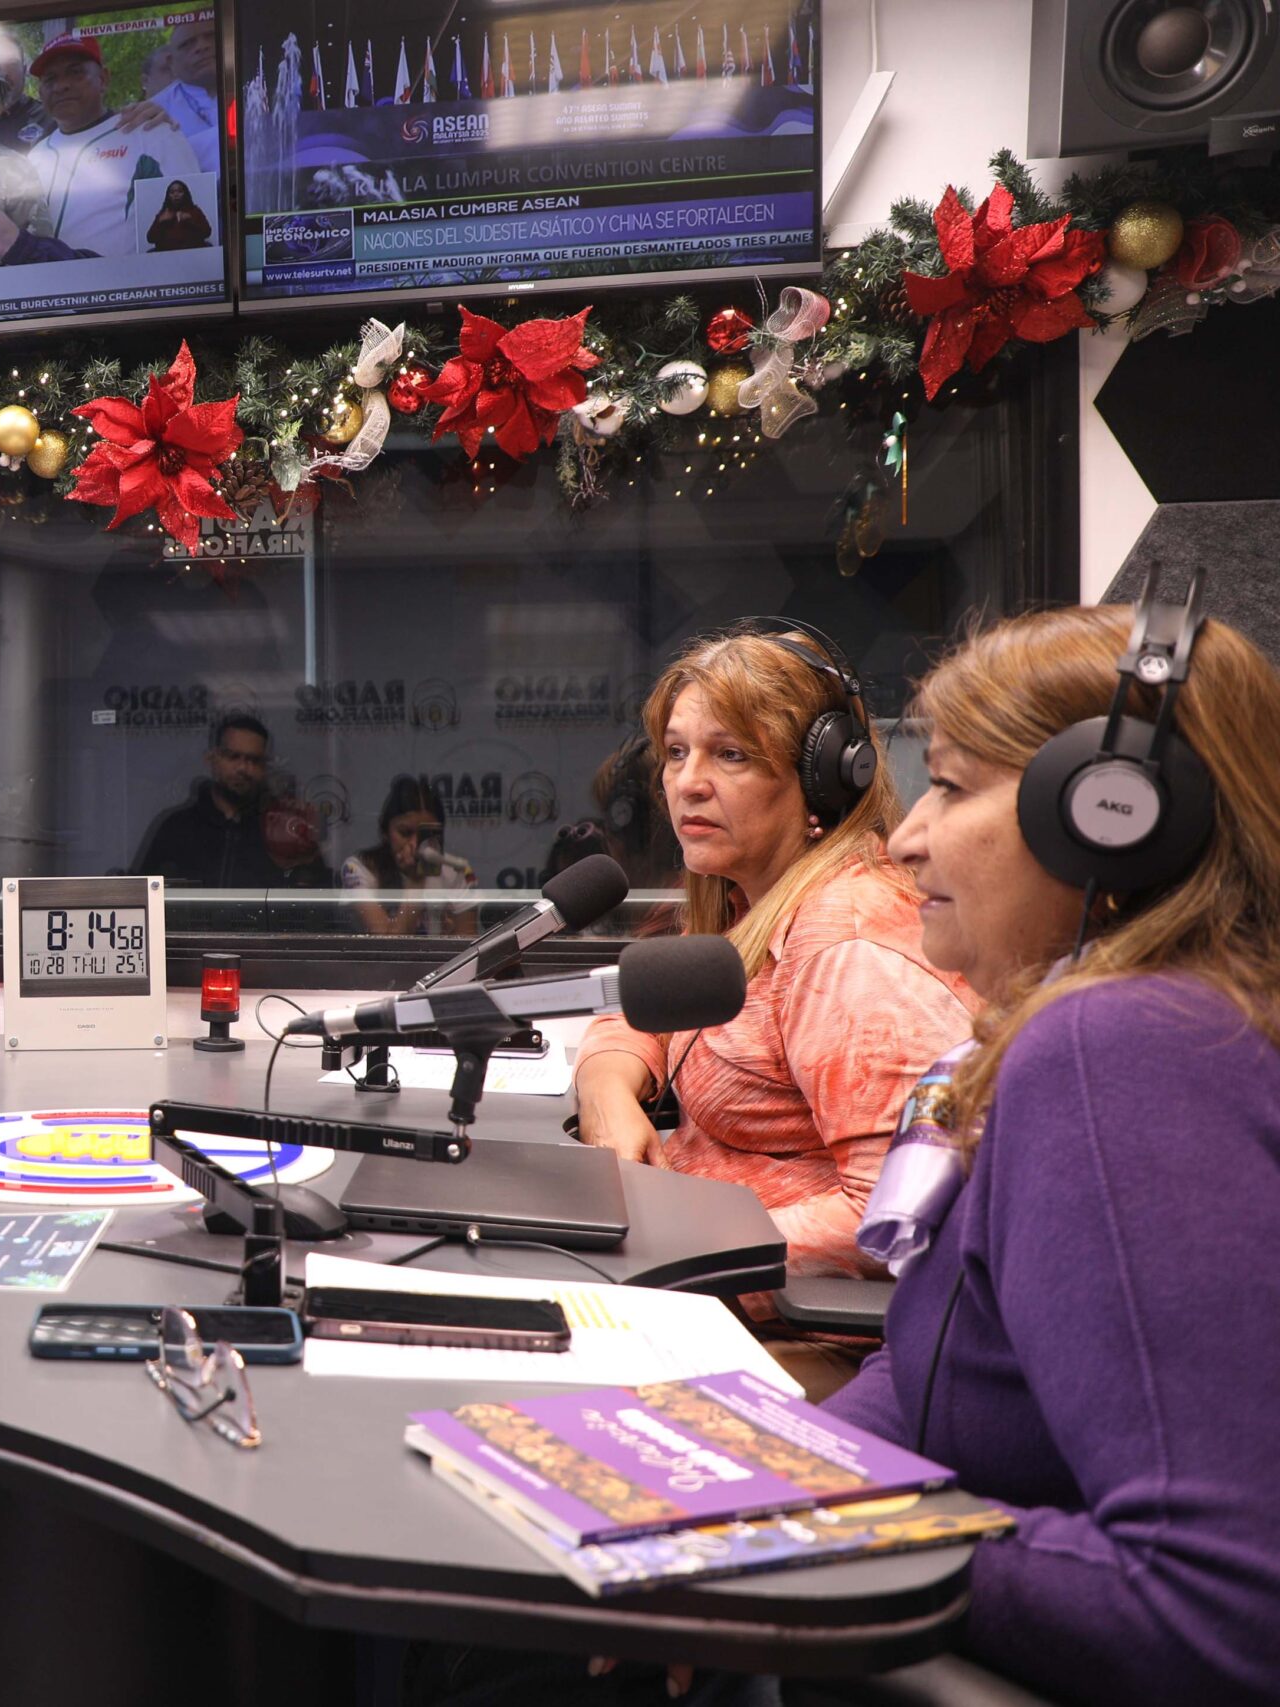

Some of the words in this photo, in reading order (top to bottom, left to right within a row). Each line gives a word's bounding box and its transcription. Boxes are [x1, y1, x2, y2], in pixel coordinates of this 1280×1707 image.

[80, 25, 112, 36] NUEVA
[114, 19, 157, 32] ESPARTA
[167, 13, 195, 25] 08:13
[198, 11, 215, 21] AM
[433, 113, 489, 133] ASEAN
[436, 168, 521, 190] LUMPUR
[527, 159, 654, 184] CONVENTION
[659, 155, 727, 174] CENTRE
[363, 207, 437, 223] MALASIA
[448, 200, 519, 216] CUMBRE
[521, 195, 580, 211] ASEAN
[266, 228, 350, 244] ECONÓMICO
[363, 230, 433, 251] NACIONES
[438, 227, 463, 246] DEL
[464, 221, 527, 243] SUDESTE
[530, 214, 594, 239] ASIÁTICO
[597, 217, 608, 233] Y
[609, 213, 653, 232] CHINA
[655, 211, 674, 229] SE
[677, 203, 775, 227] FORTALECEN
[359, 259, 429, 274] PRESIDENTE
[432, 256, 484, 269] MADURO
[487, 251, 540, 265] INFORMA
[544, 250, 569, 262] QUE
[572, 247, 621, 259] FUERON
[624, 238, 731, 255] DESMANTELADOS
[735, 235, 766, 247] TRES
[266, 267, 352, 281] www.telesurtv.net
[21, 295, 89, 310] BUREVESTNIK
[91, 294, 107, 304] NO
[108, 288, 157, 302] CREARÁN
[159, 284, 217, 297] TENSIONES
[1096, 798, 1134, 816] AKG
[47, 911, 116, 950] 8:14
[117, 926, 143, 950] 58
[72, 956, 105, 974] THU
